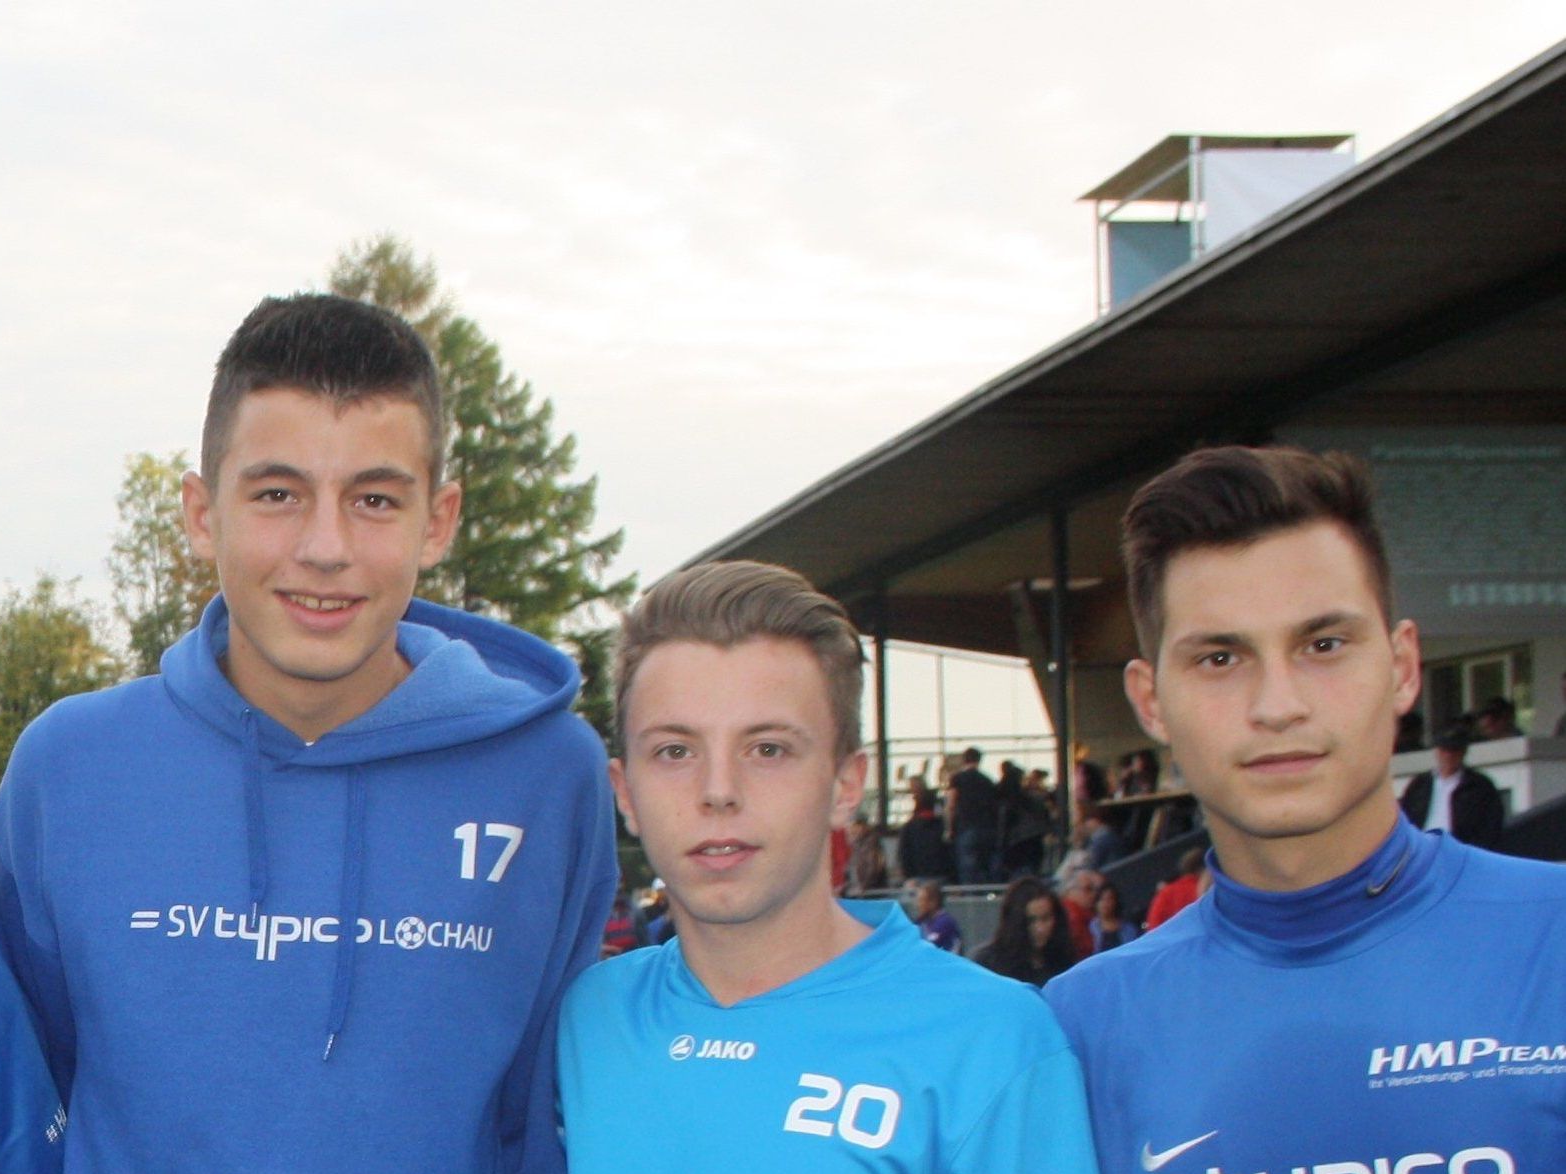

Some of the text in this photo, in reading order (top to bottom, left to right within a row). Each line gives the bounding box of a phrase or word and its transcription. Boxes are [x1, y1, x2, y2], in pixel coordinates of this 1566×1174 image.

[454, 823, 524, 883] 17
[167, 904, 210, 937] SV
[696, 1039, 756, 1061] JAKO
[784, 1073, 901, 1149] 20
